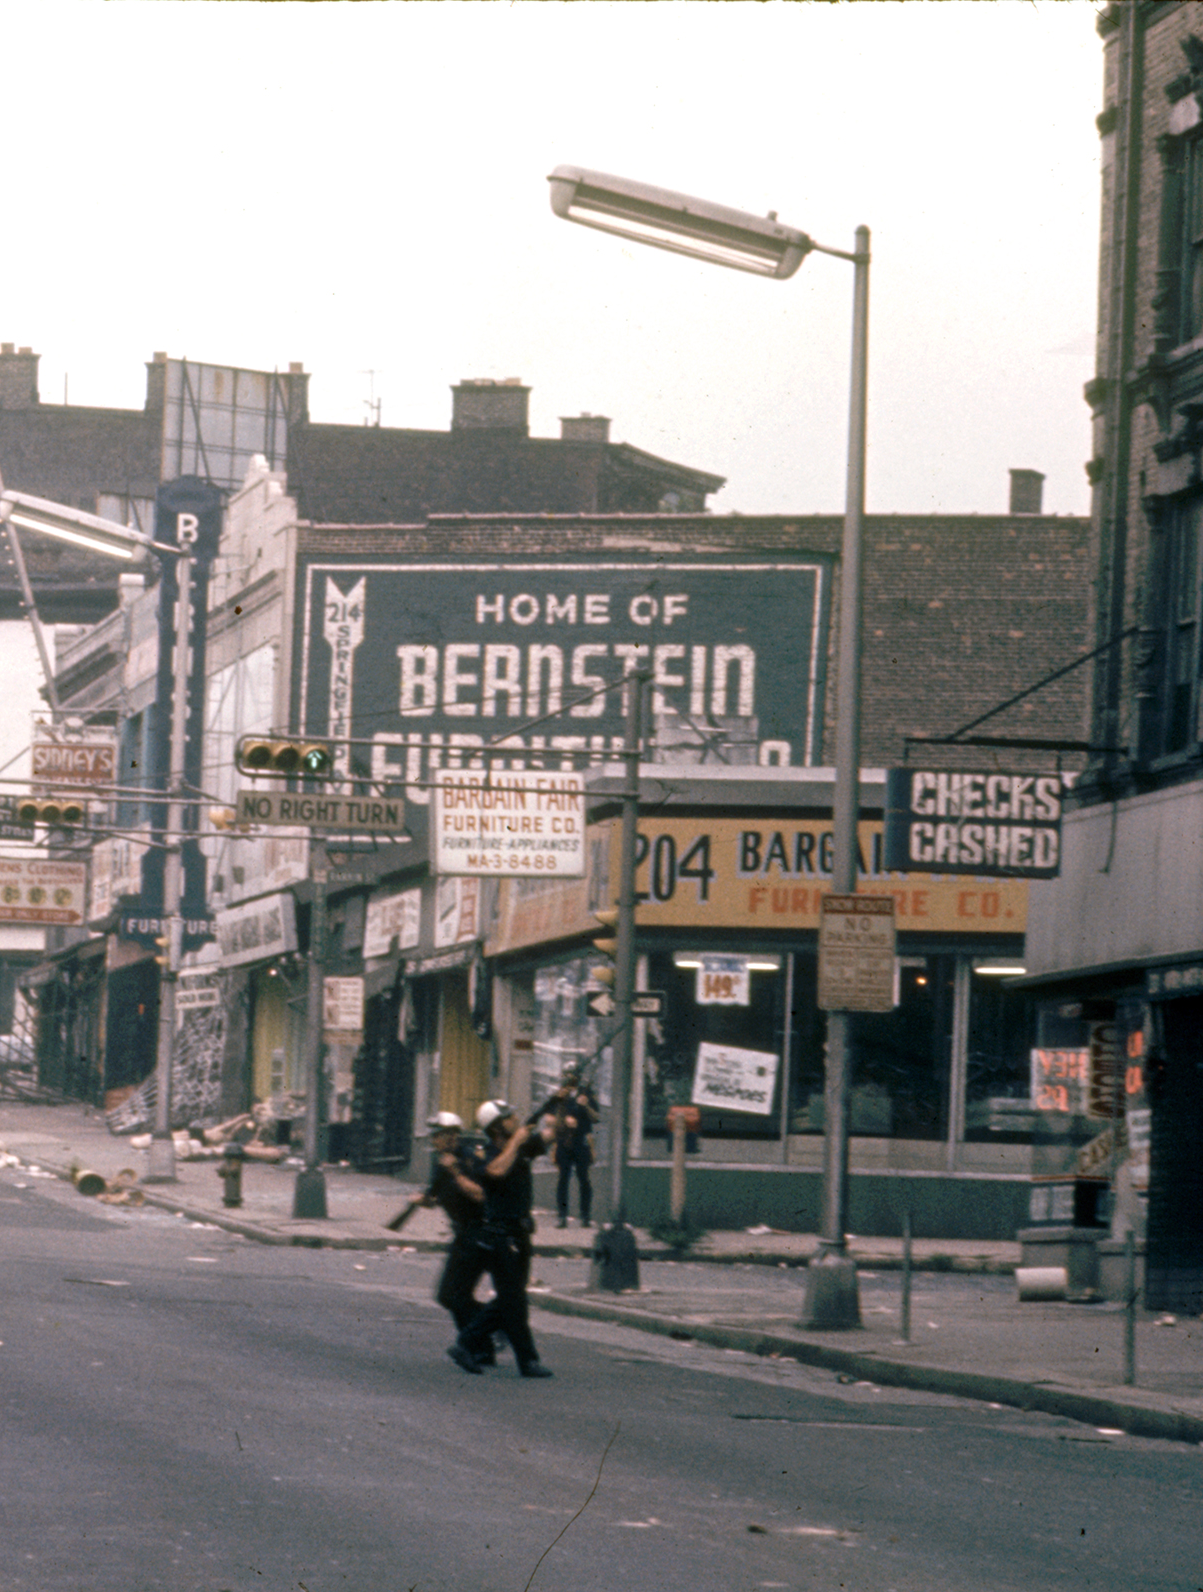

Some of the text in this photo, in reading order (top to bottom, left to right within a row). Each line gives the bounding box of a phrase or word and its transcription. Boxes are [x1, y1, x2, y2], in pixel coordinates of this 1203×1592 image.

[327, 602, 362, 623] 214
[475, 593, 690, 626] HOME OF
[397, 642, 757, 718] BERNSTEIN
[536, 779, 581, 812] FAIR
[910, 771, 1062, 822] CHECKS
[243, 797, 399, 825] NO RIGHT TURN
[442, 814, 544, 834] FURNITURE
[909, 822, 1059, 869] CASHED
[467, 853, 558, 870] MA-3-8488
[957, 891, 1016, 919] CO.
[845, 916, 871, 932] NO
